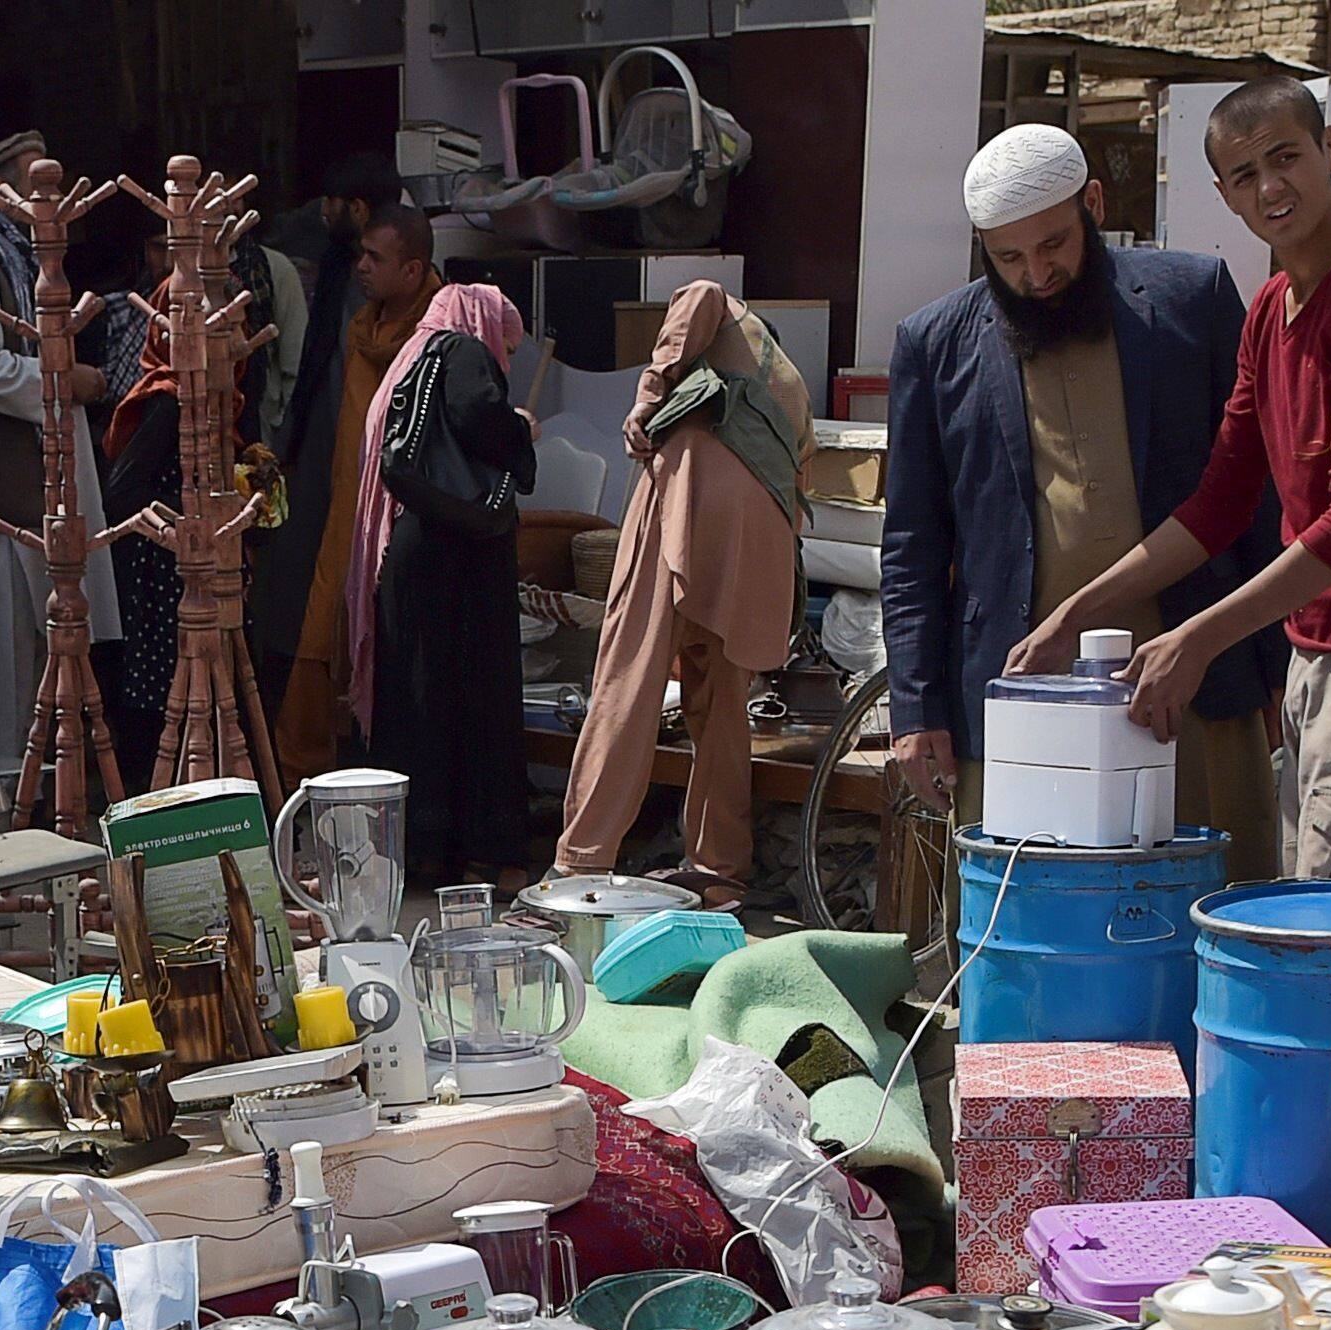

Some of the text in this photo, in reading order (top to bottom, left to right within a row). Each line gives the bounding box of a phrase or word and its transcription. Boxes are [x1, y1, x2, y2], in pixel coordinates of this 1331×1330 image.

[124, 819, 251, 853] электрошашлычница 6
[431, 1291, 467, 1310] GEEPAS
